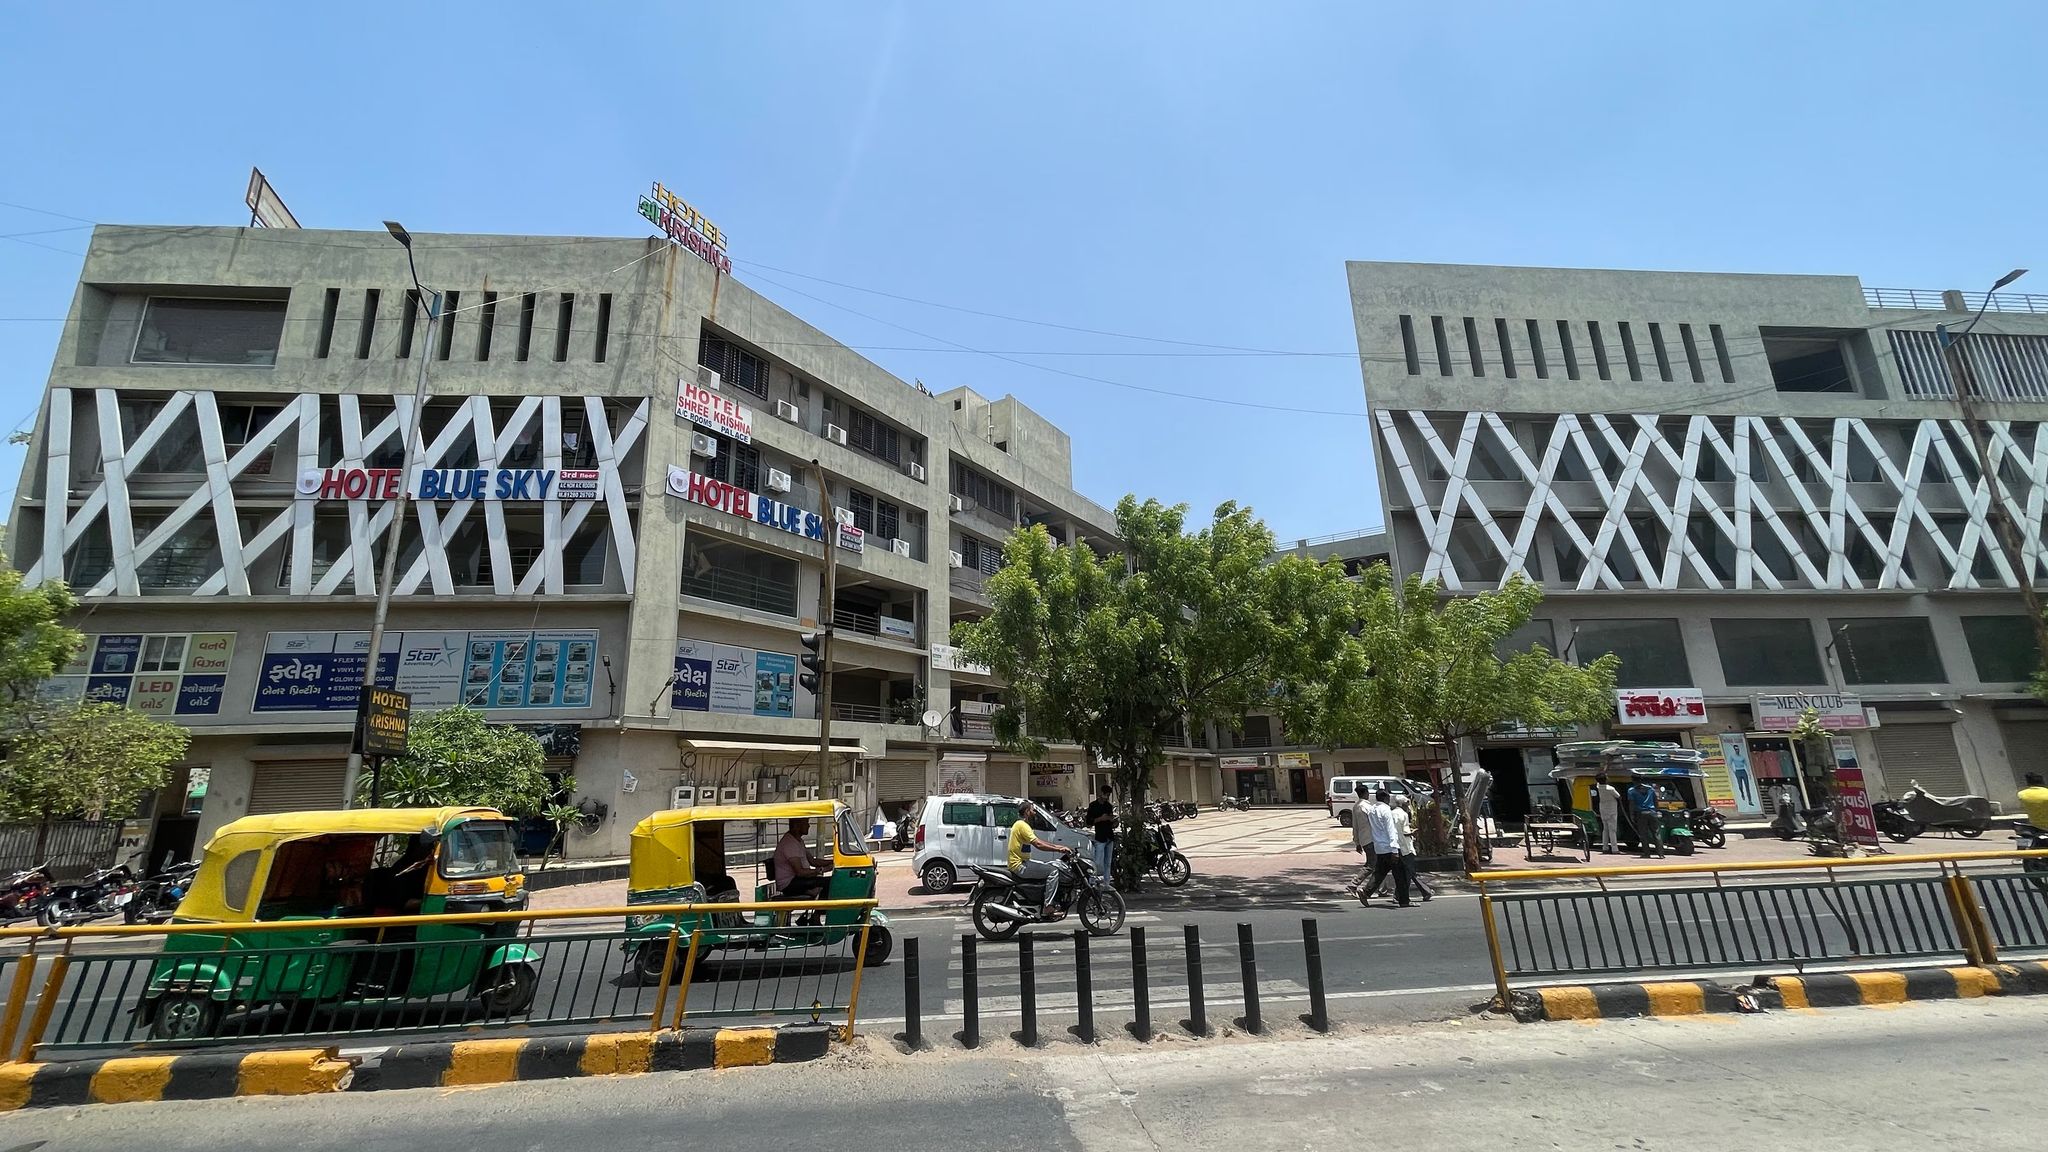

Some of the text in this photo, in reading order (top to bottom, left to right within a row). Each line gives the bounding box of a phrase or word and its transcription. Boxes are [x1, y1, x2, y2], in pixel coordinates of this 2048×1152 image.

[657, 183, 727, 250] HOTEL
[659, 207, 732, 276] KRISHNA
[685, 382, 744, 421] HOTEL
[678, 395, 752, 436] SHREE KRISHNA
[690, 413, 713, 428] ROOMS
[720, 425, 749, 443] PALACE
[320, 468, 556, 500] HOTE BLUE SKY
[561, 471, 577, 479] 3rd
[687, 471, 825, 541] HOTEL BLUE SK
[286, 640, 305, 649] Star
[354, 640, 370, 649] Sta
[405, 650, 441, 662] Star
[716, 659, 741, 672] Star
[138, 681, 174, 693] LED
[372, 690, 409, 711] HOTEL
[1811, 695, 1843, 709] CLUB
[369, 713, 406, 732] KRISHNA
